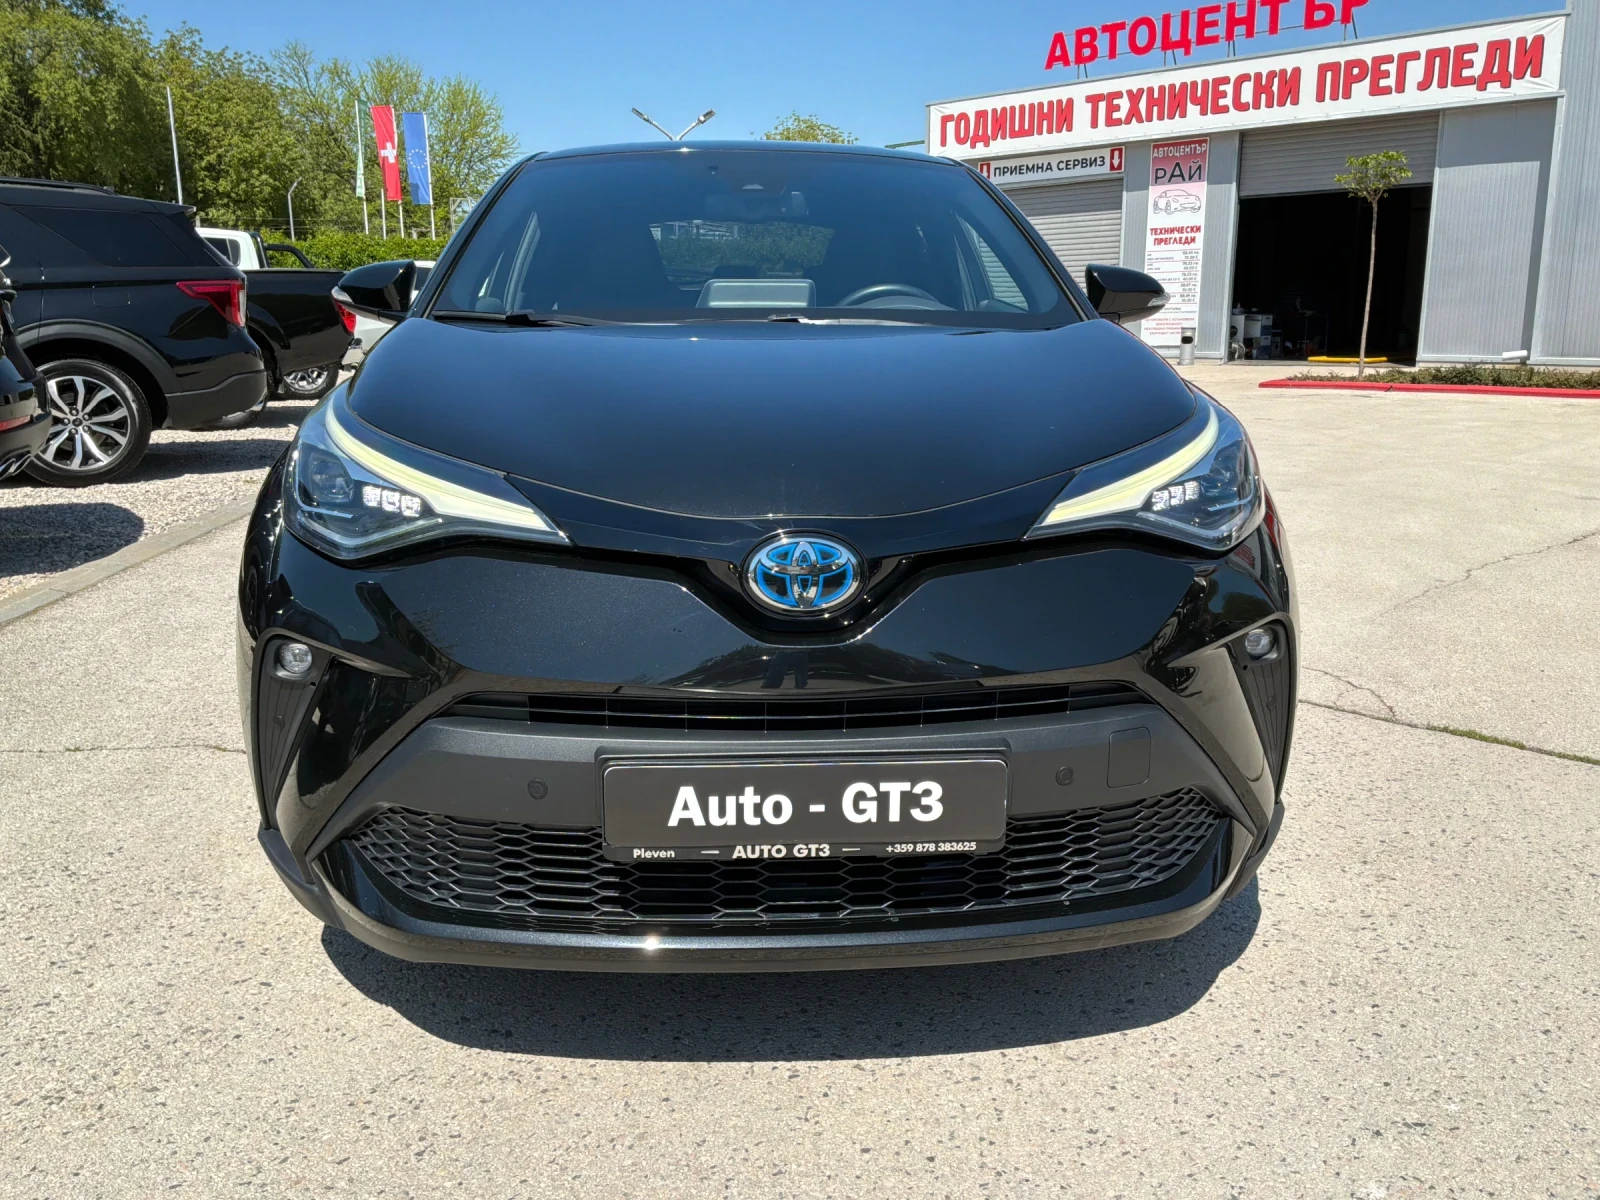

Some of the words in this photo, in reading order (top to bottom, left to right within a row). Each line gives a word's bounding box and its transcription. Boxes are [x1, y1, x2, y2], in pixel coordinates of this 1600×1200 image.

[940, 97, 1074, 149] ГОДИШНИ
[1085, 66, 1302, 129] ТЕХНИЧЕСКИ
[1315, 34, 1545, 103] ПРЕГЛЕДИ
[1152, 142, 1207, 159] АВТОЦЕНТЪР
[993, 162, 1053, 178] ПРИЕМНА
[1056, 155, 1106, 171] СЕРВИЗ
[1150, 225, 1201, 235] ТЕХНИЧЕСКИ
[1153, 236, 1196, 246] ПРЕГЛЕДИ
[667, 785, 793, 827] Auto
[841, 781, 944, 824] GT3
[632, 847, 676, 859] Pleven
[732, 844, 787, 859] AUTO
[793, 843, 831, 857] GT3
[885, 844, 914, 853] +359
[915, 843, 936, 852] 878
[937, 841, 977, 852] 383625
